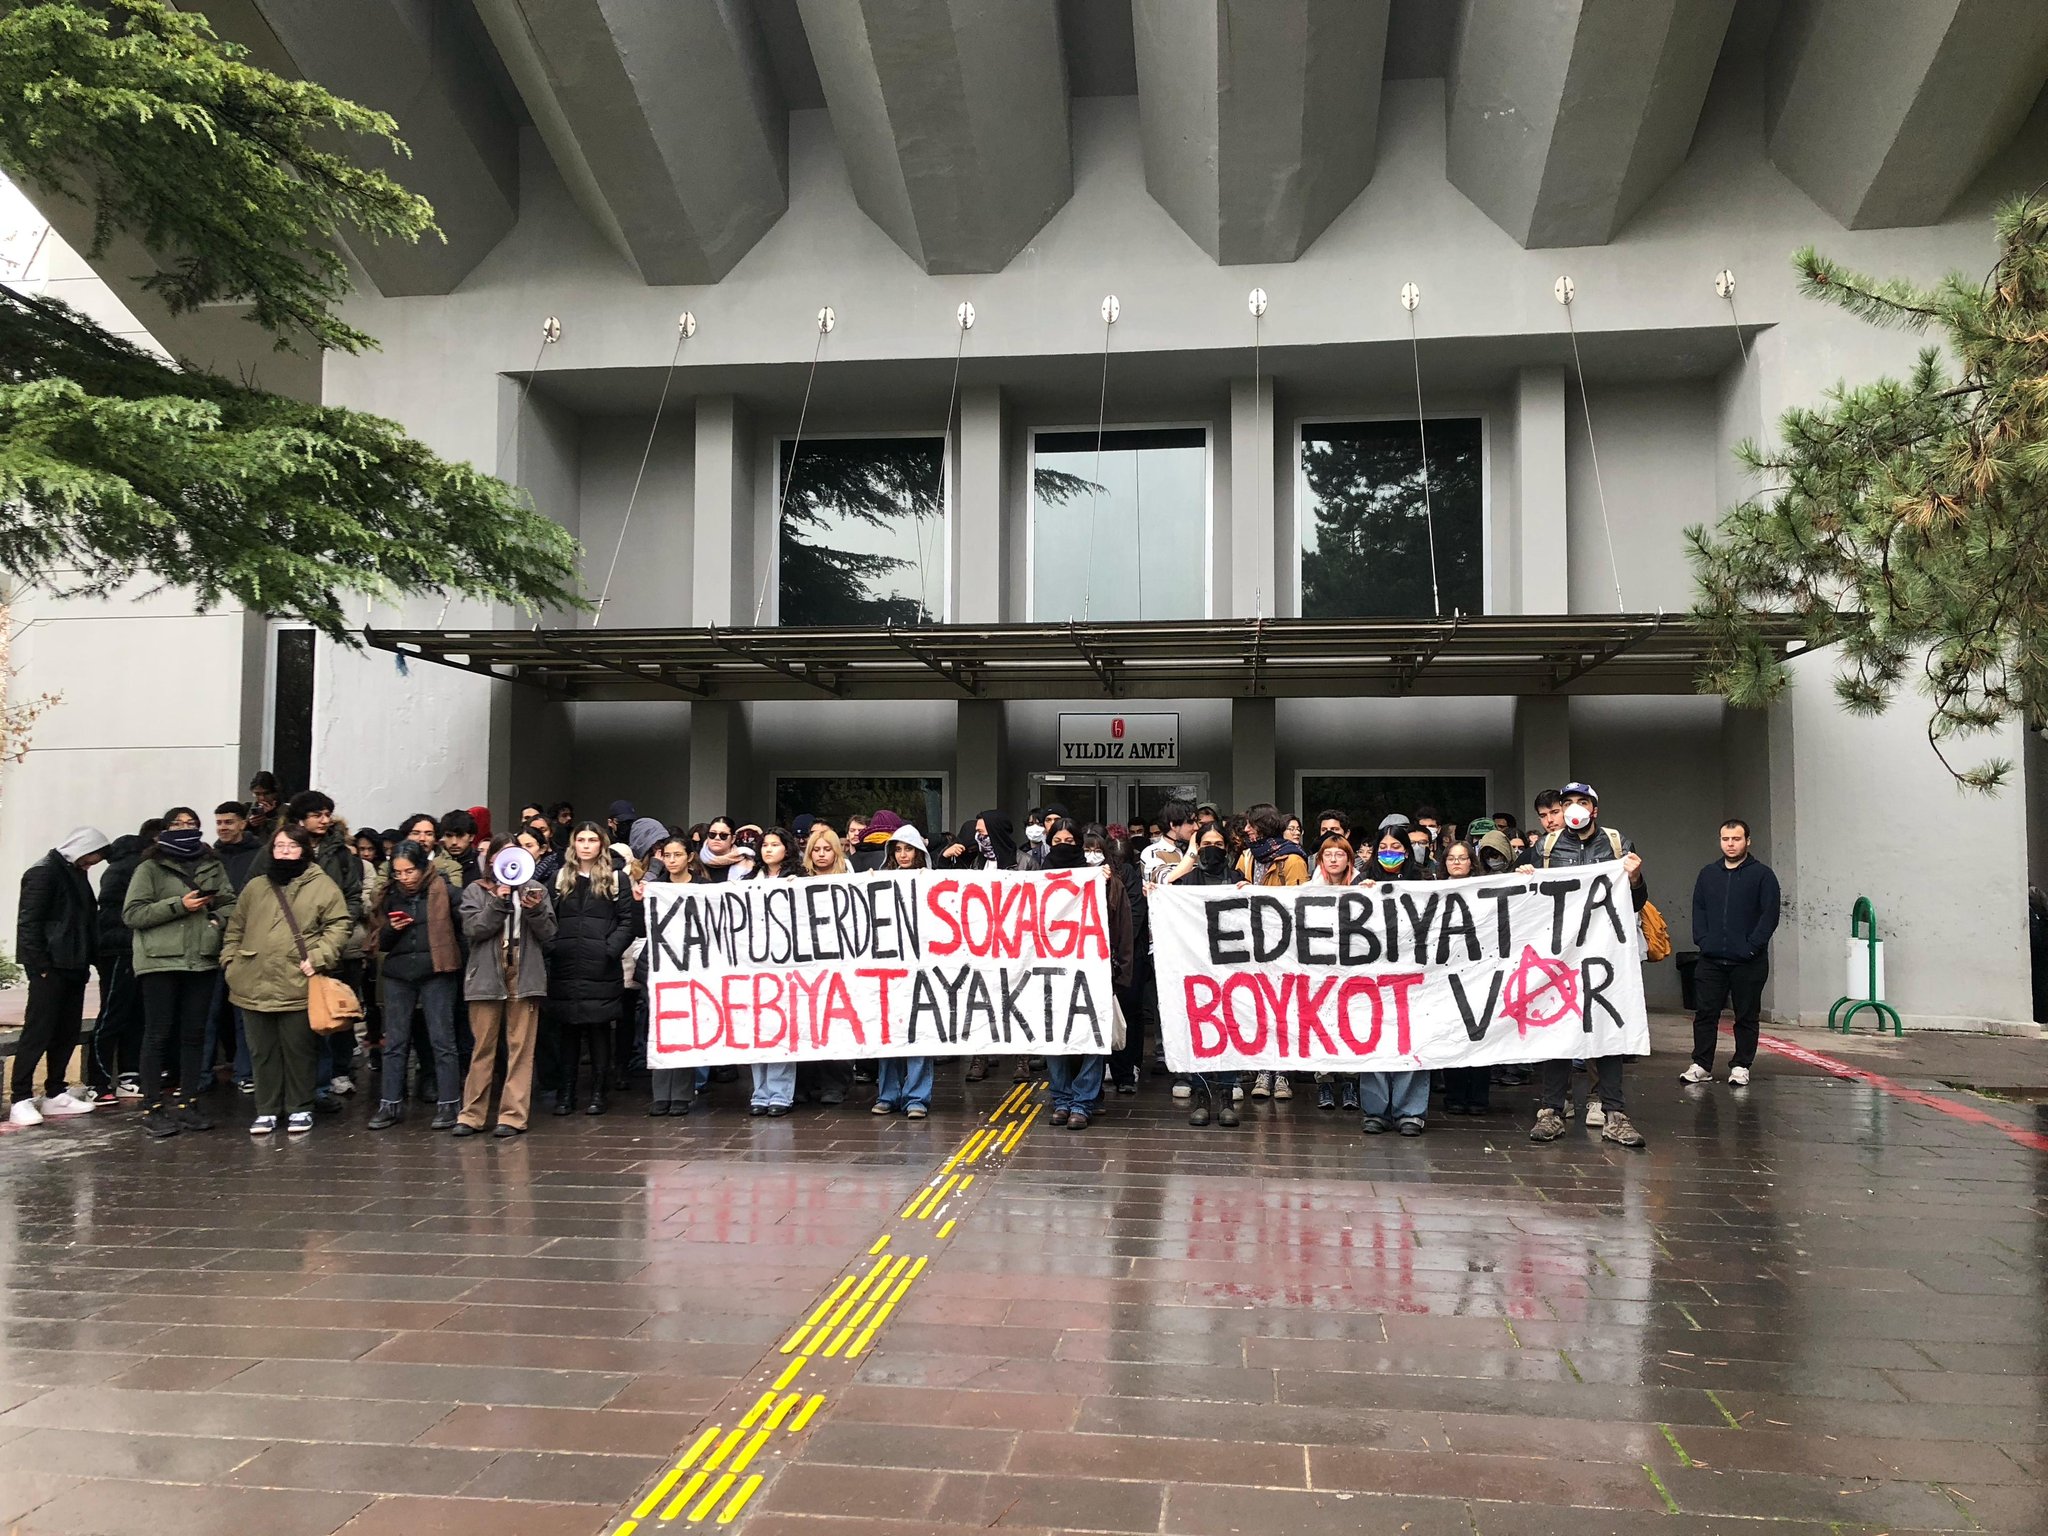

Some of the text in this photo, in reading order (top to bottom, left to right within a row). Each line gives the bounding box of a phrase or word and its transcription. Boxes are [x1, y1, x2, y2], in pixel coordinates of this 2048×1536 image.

[1063, 737, 1175, 759] YILDIZ AMFİ
[650, 871, 1109, 971] KAMPÜSLERDEN SOKAĞA
[1205, 874, 1627, 966] EDEBİYAT'TA
[655, 964, 1105, 1053] EDEBİYAT AYAKTA
[1184, 944, 1625, 1058] BOYKOT VAR
